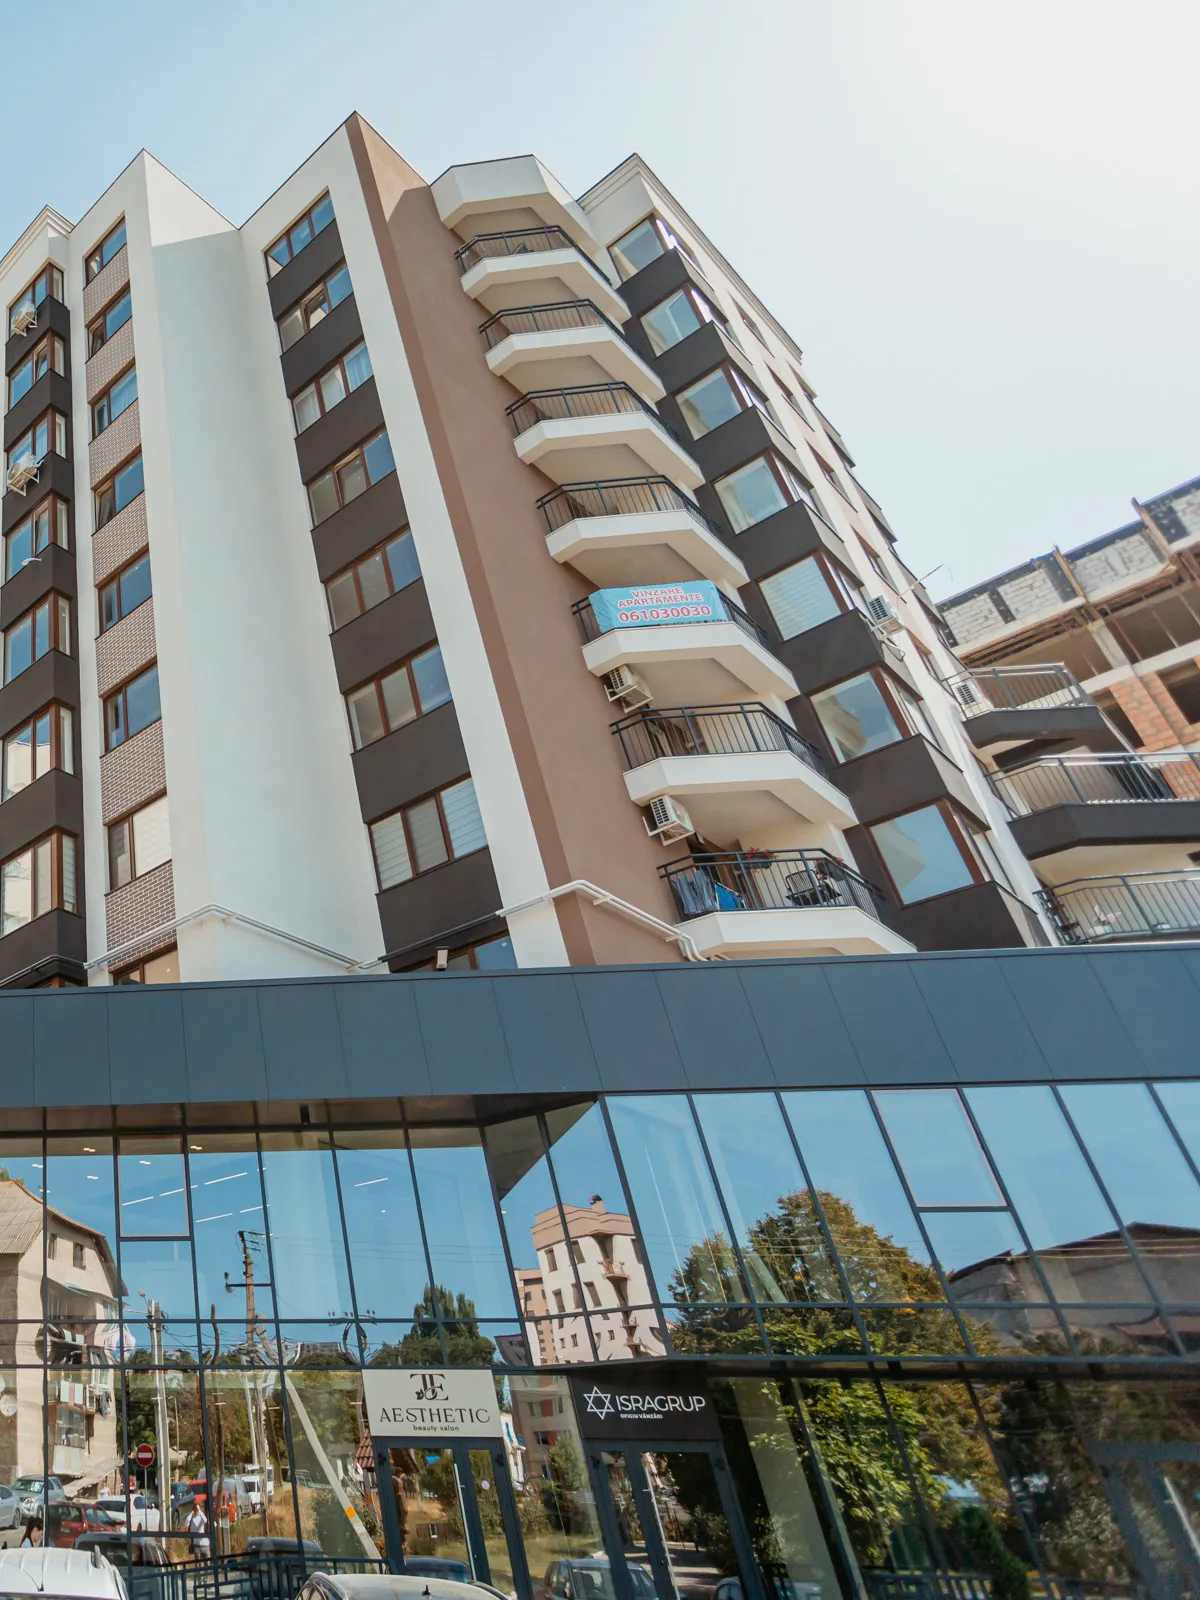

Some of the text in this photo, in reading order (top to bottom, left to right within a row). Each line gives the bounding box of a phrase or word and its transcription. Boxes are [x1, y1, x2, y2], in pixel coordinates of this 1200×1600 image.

[619, 594, 702, 607] APARTAMENTE
[619, 606, 711, 621] 061030030
[615, 1395, 706, 1412] ISRAGRUP
[380, 1407, 491, 1424] AESTHETIC
[412, 1424, 460, 1432] beauty salon
